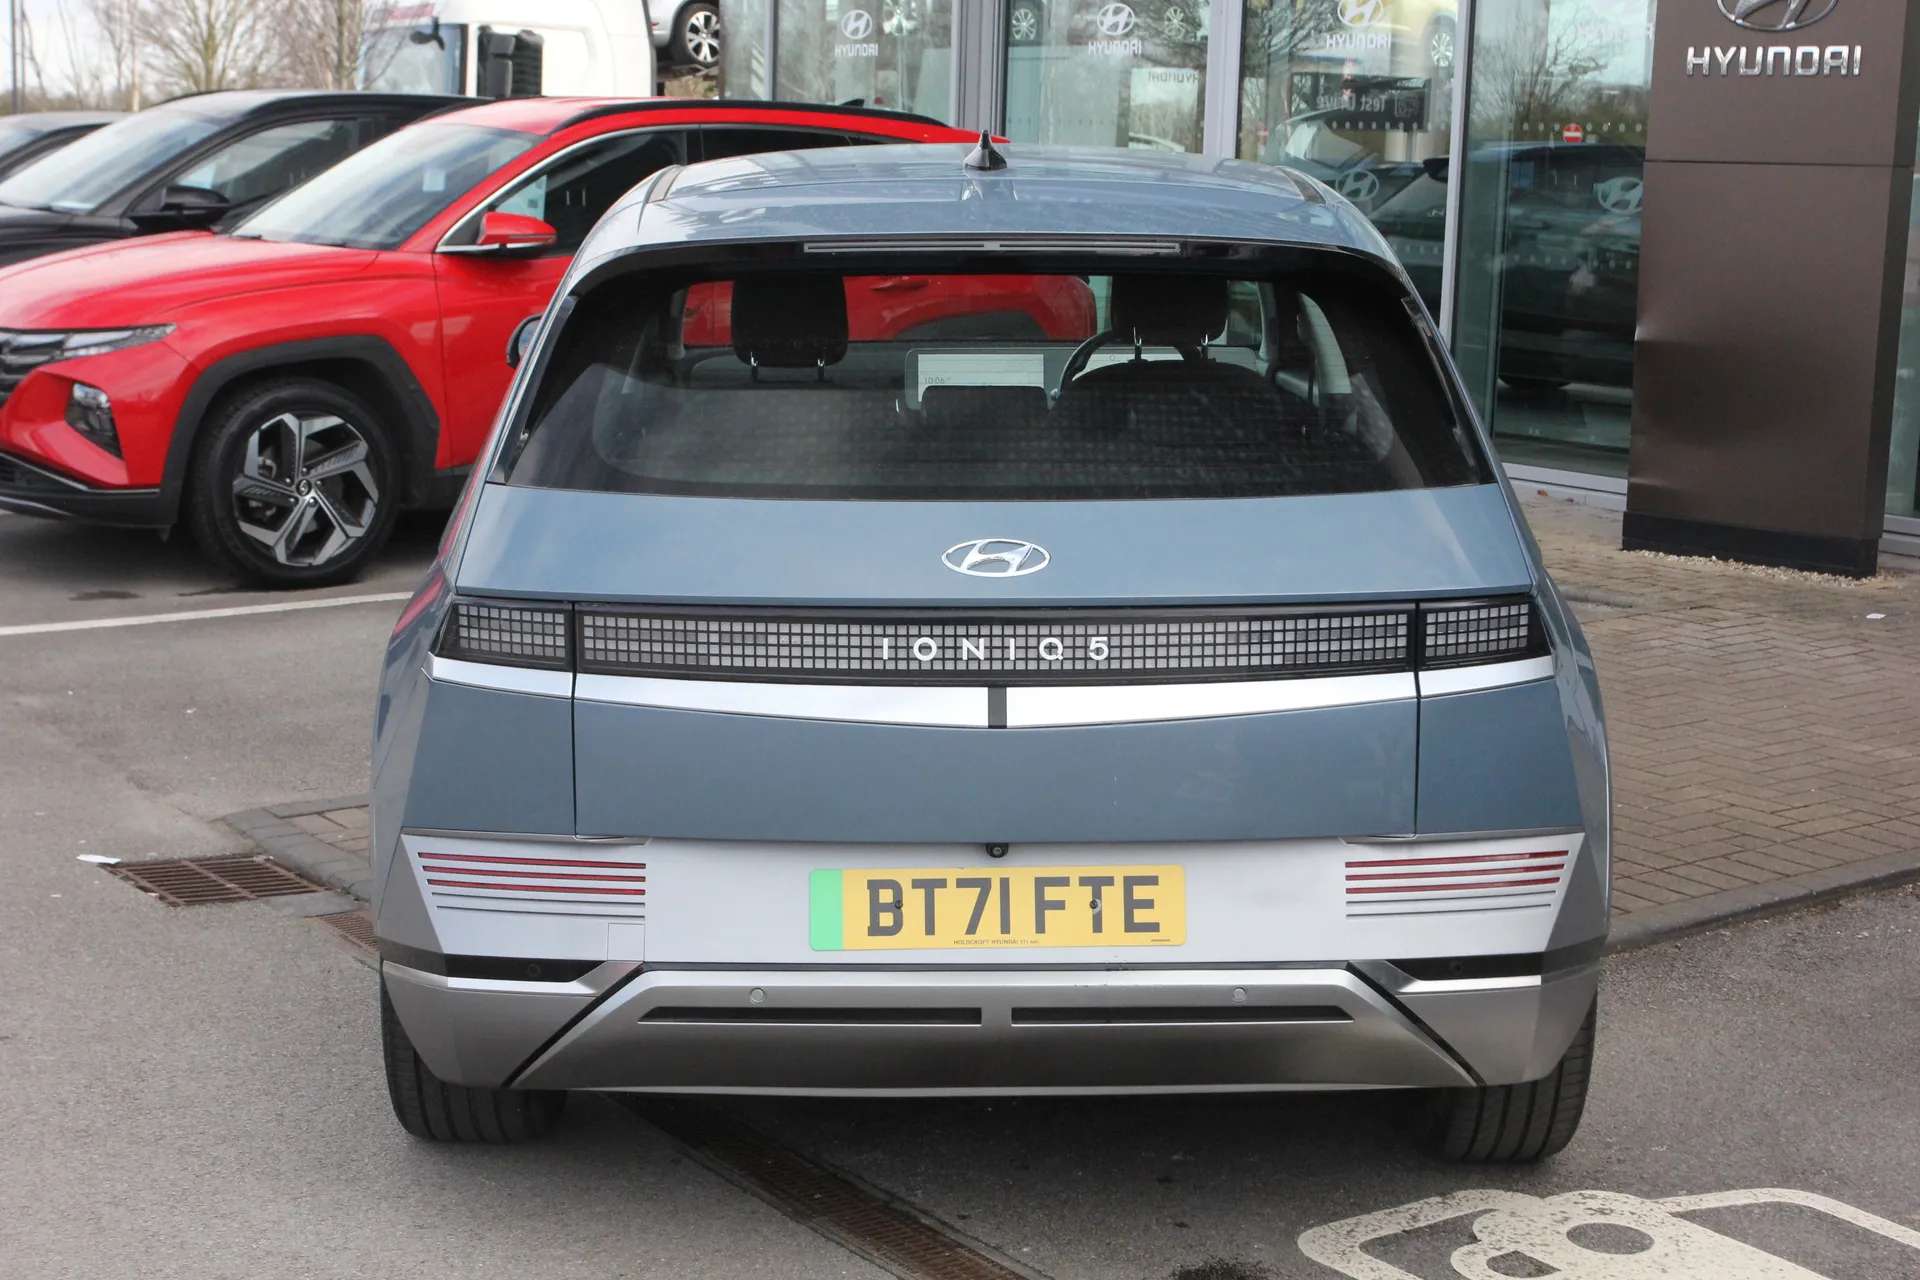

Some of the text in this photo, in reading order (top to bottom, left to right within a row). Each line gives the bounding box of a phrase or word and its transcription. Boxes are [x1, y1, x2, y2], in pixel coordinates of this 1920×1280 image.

[834, 43, 879, 57] HYUNDAI
[1088, 39, 1142, 57] HYUNDAI
[1326, 32, 1392, 49] HYUNDAI
[1686, 45, 1862, 76] HYUNDAI
[882, 636, 1109, 661] IONIQ 5
[866, 875, 1160, 937] BT71 FTE
